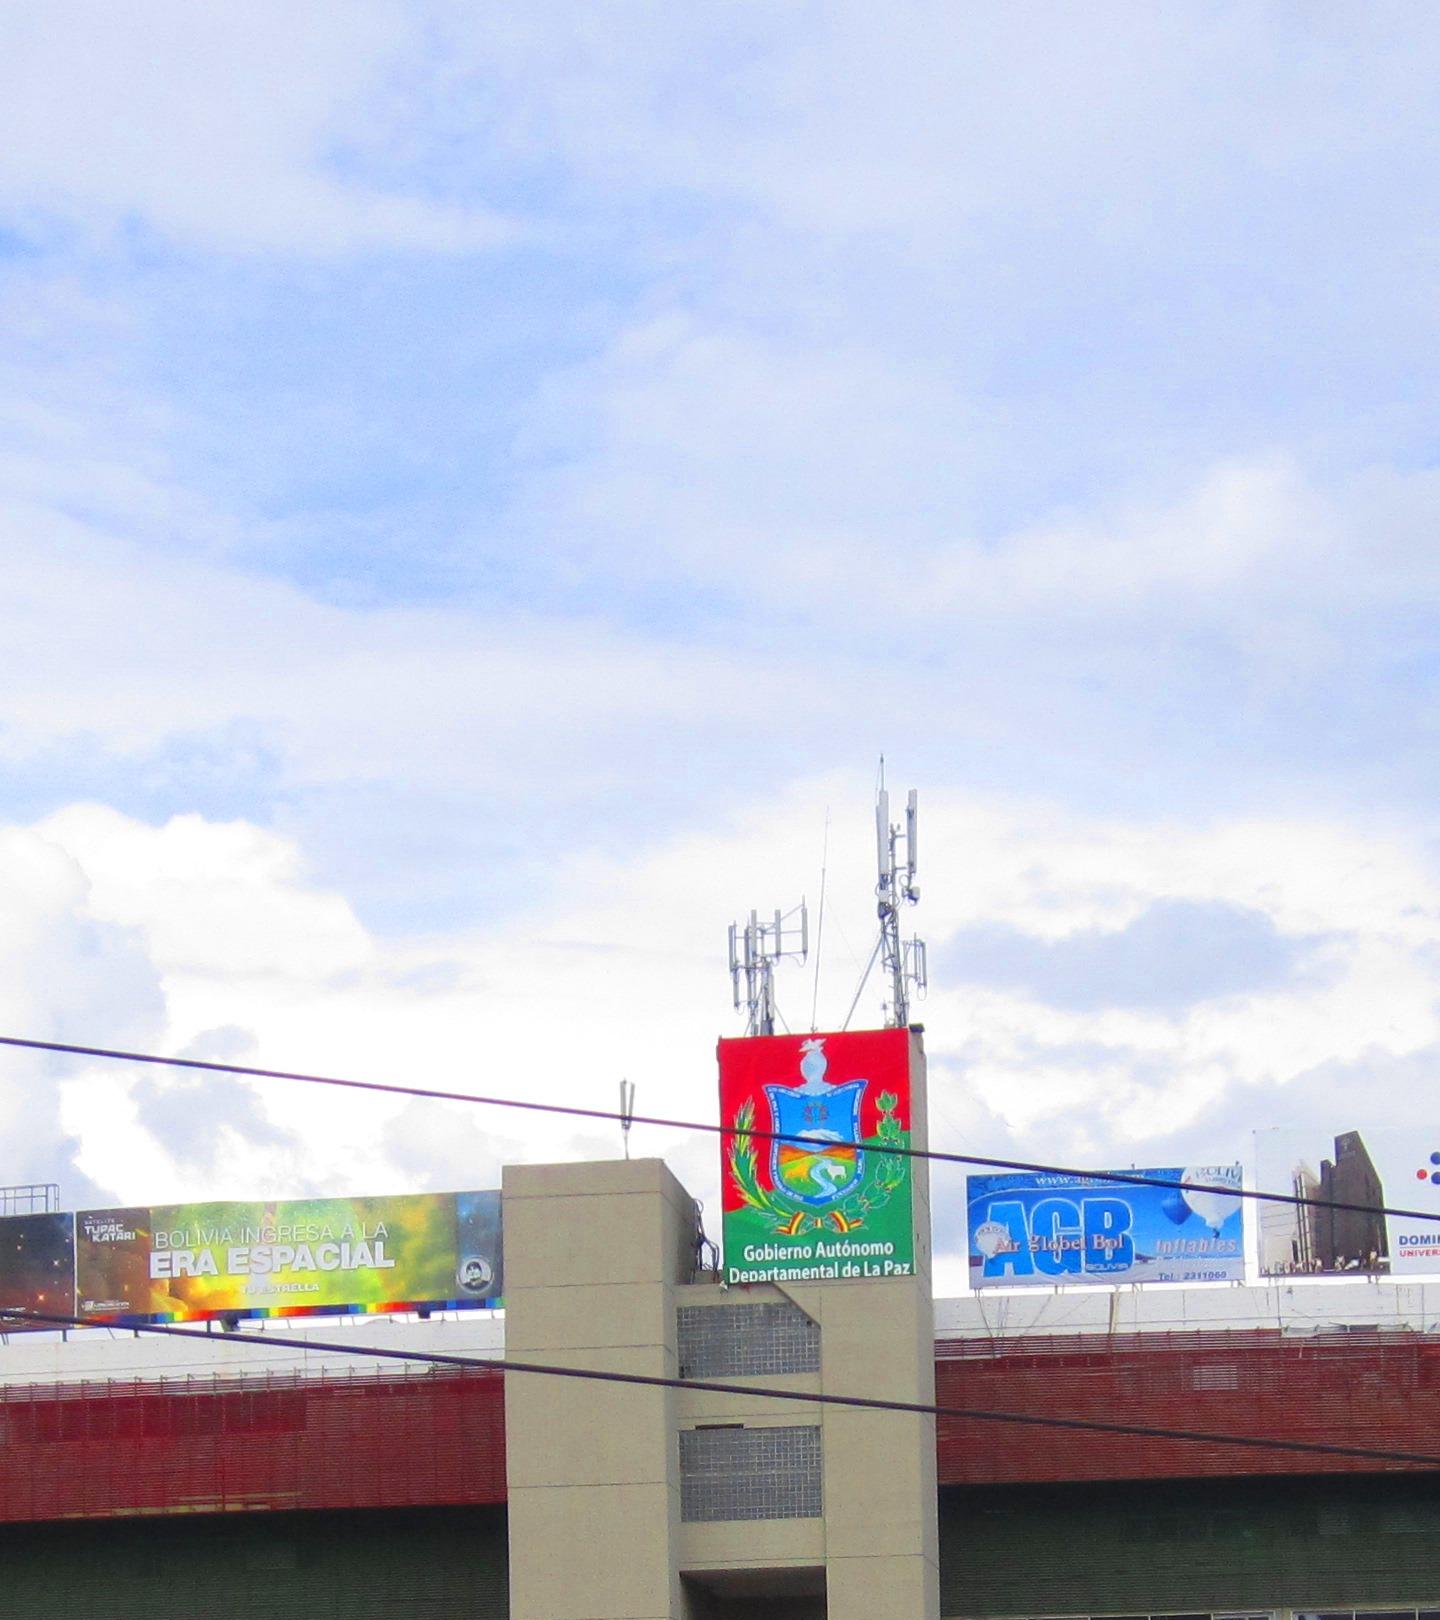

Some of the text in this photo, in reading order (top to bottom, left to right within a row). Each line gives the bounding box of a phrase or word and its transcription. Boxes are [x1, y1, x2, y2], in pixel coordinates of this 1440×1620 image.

[84, 1224, 124, 1235] TUPAC
[92, 1232, 136, 1242] KATARI
[154, 1221, 389, 1249] BOLIVIA INGRESA A LA
[982, 1196, 1136, 1279] AGB
[743, 1239, 894, 1261] Gobierno Autónomo
[1093, 1233, 1125, 1250] Bol
[149, 1241, 396, 1279] ERA ESPACIAL
[729, 1260, 911, 1283] Departamental de La Paz
